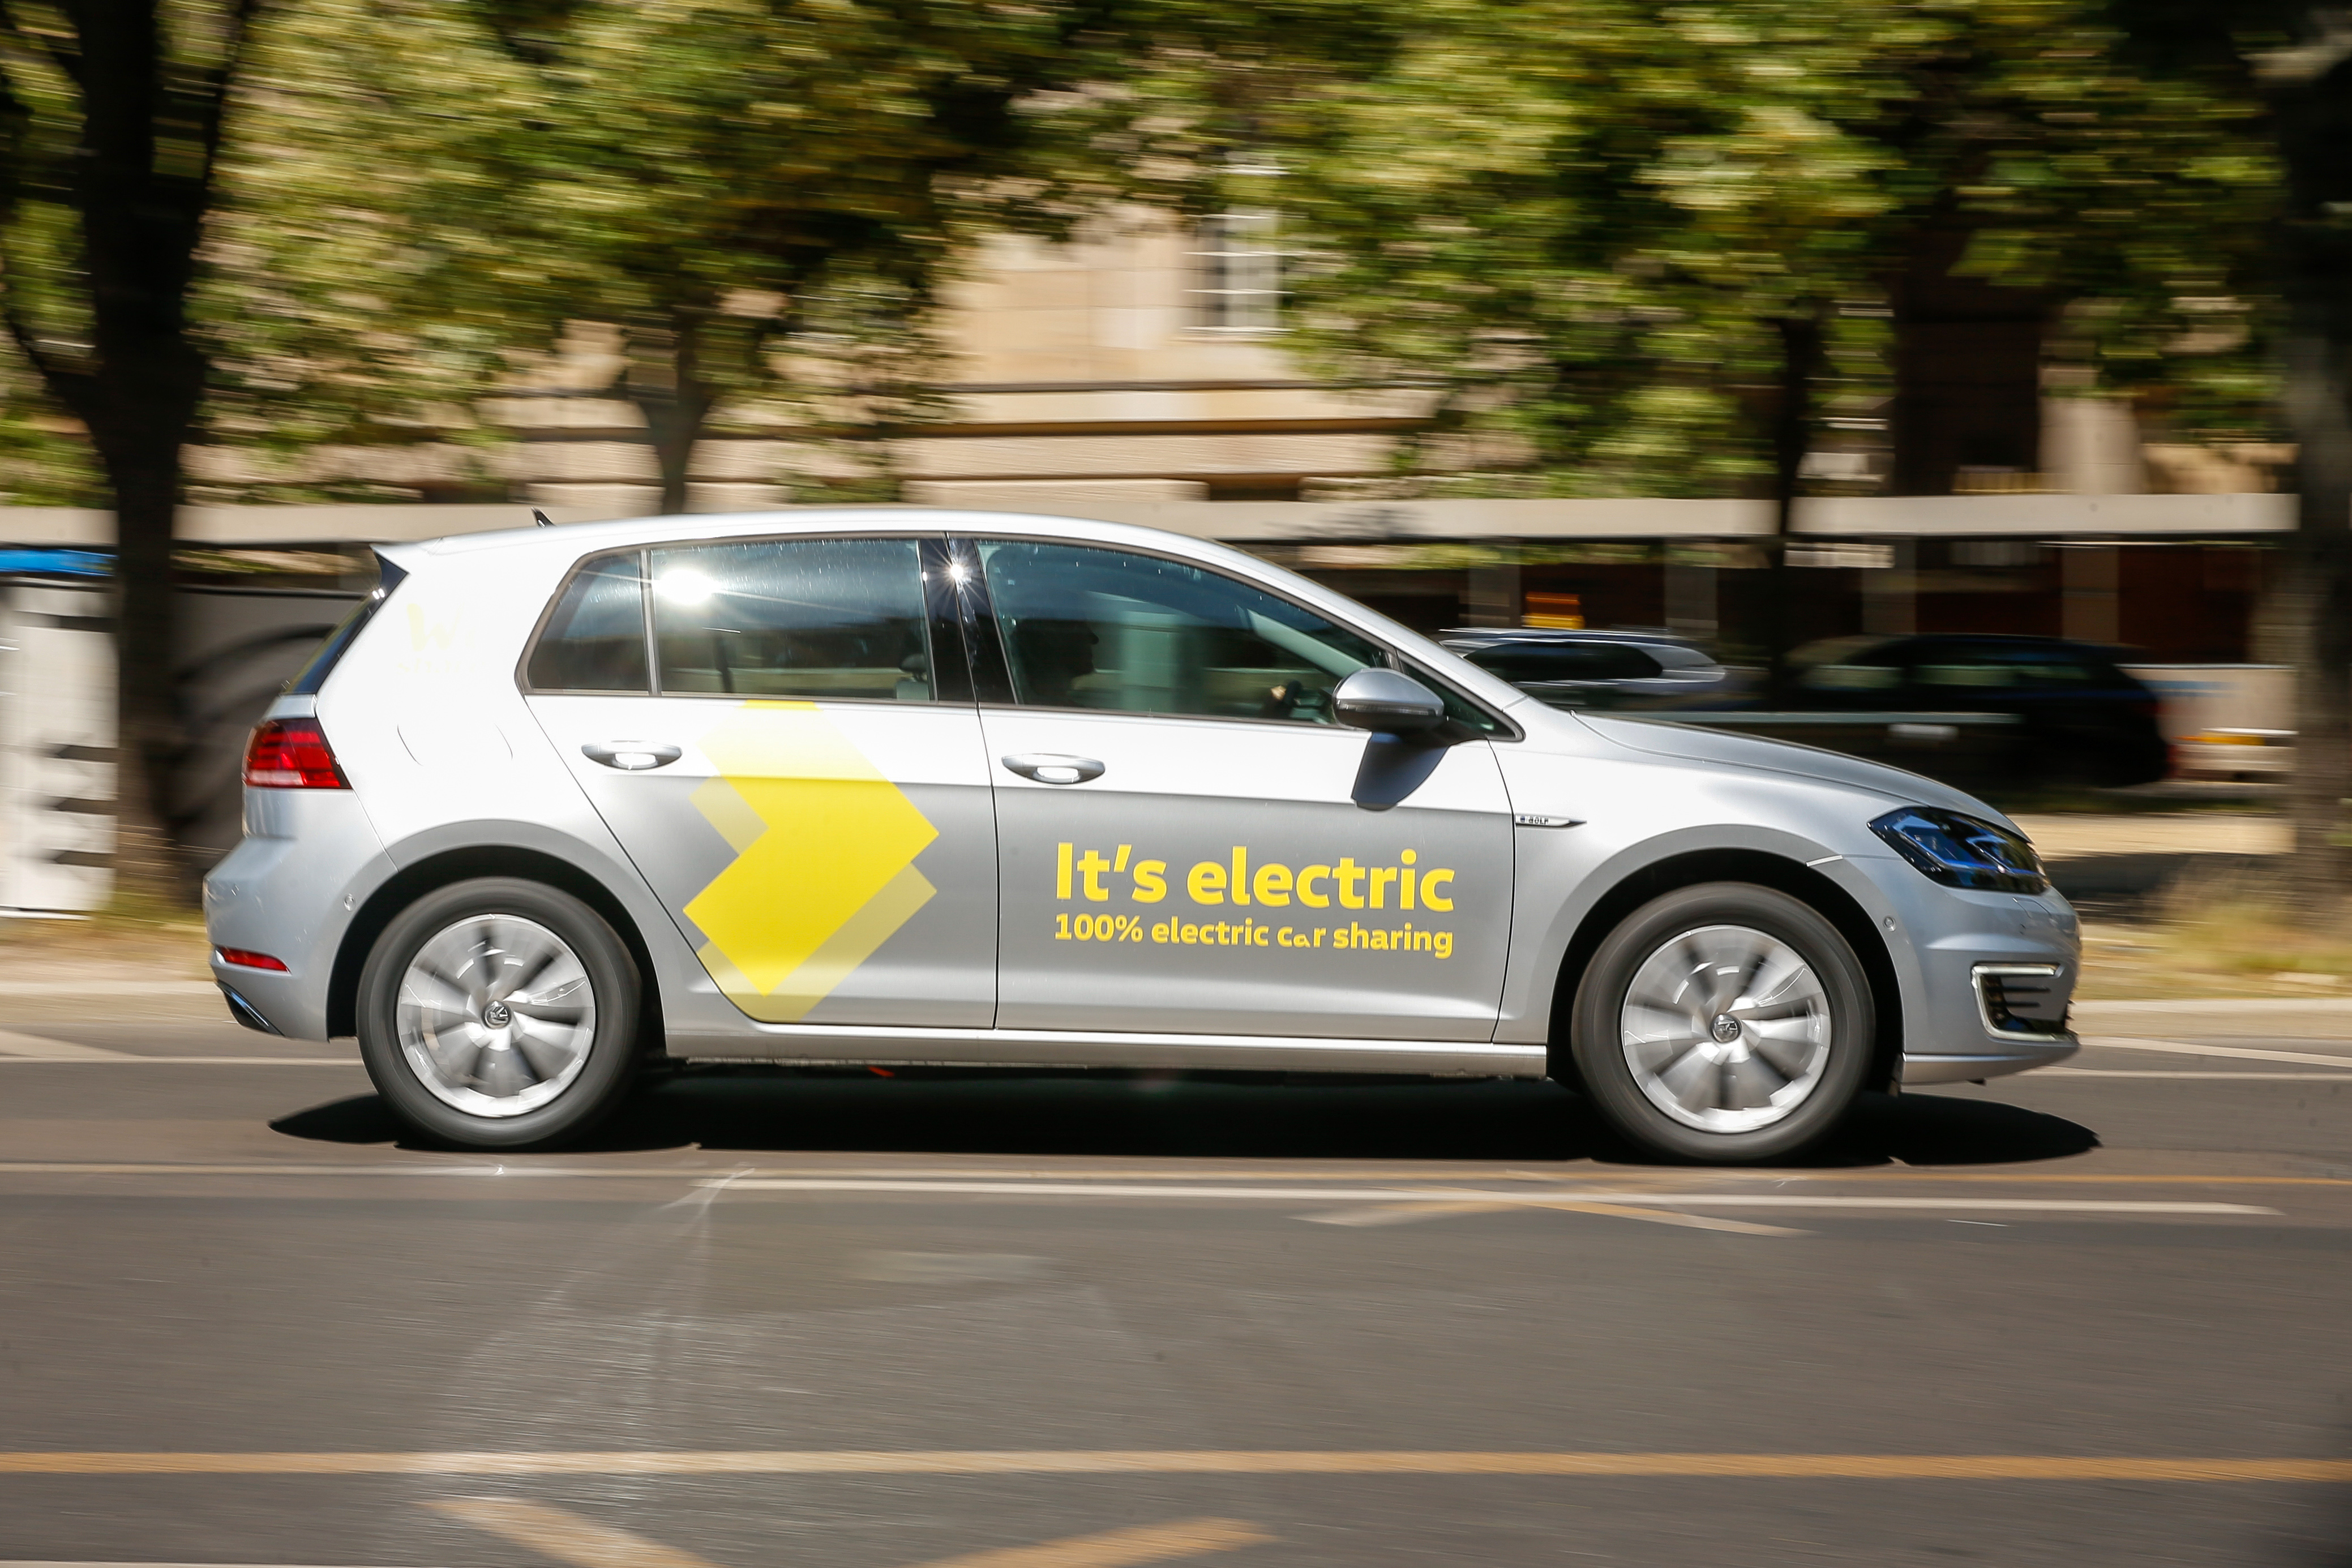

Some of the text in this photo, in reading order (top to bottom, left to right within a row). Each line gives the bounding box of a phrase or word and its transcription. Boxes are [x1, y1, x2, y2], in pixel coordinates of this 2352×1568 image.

[1055, 842, 1456, 912] It's electric
[1054, 912, 1454, 959] 100% electric car sharing
